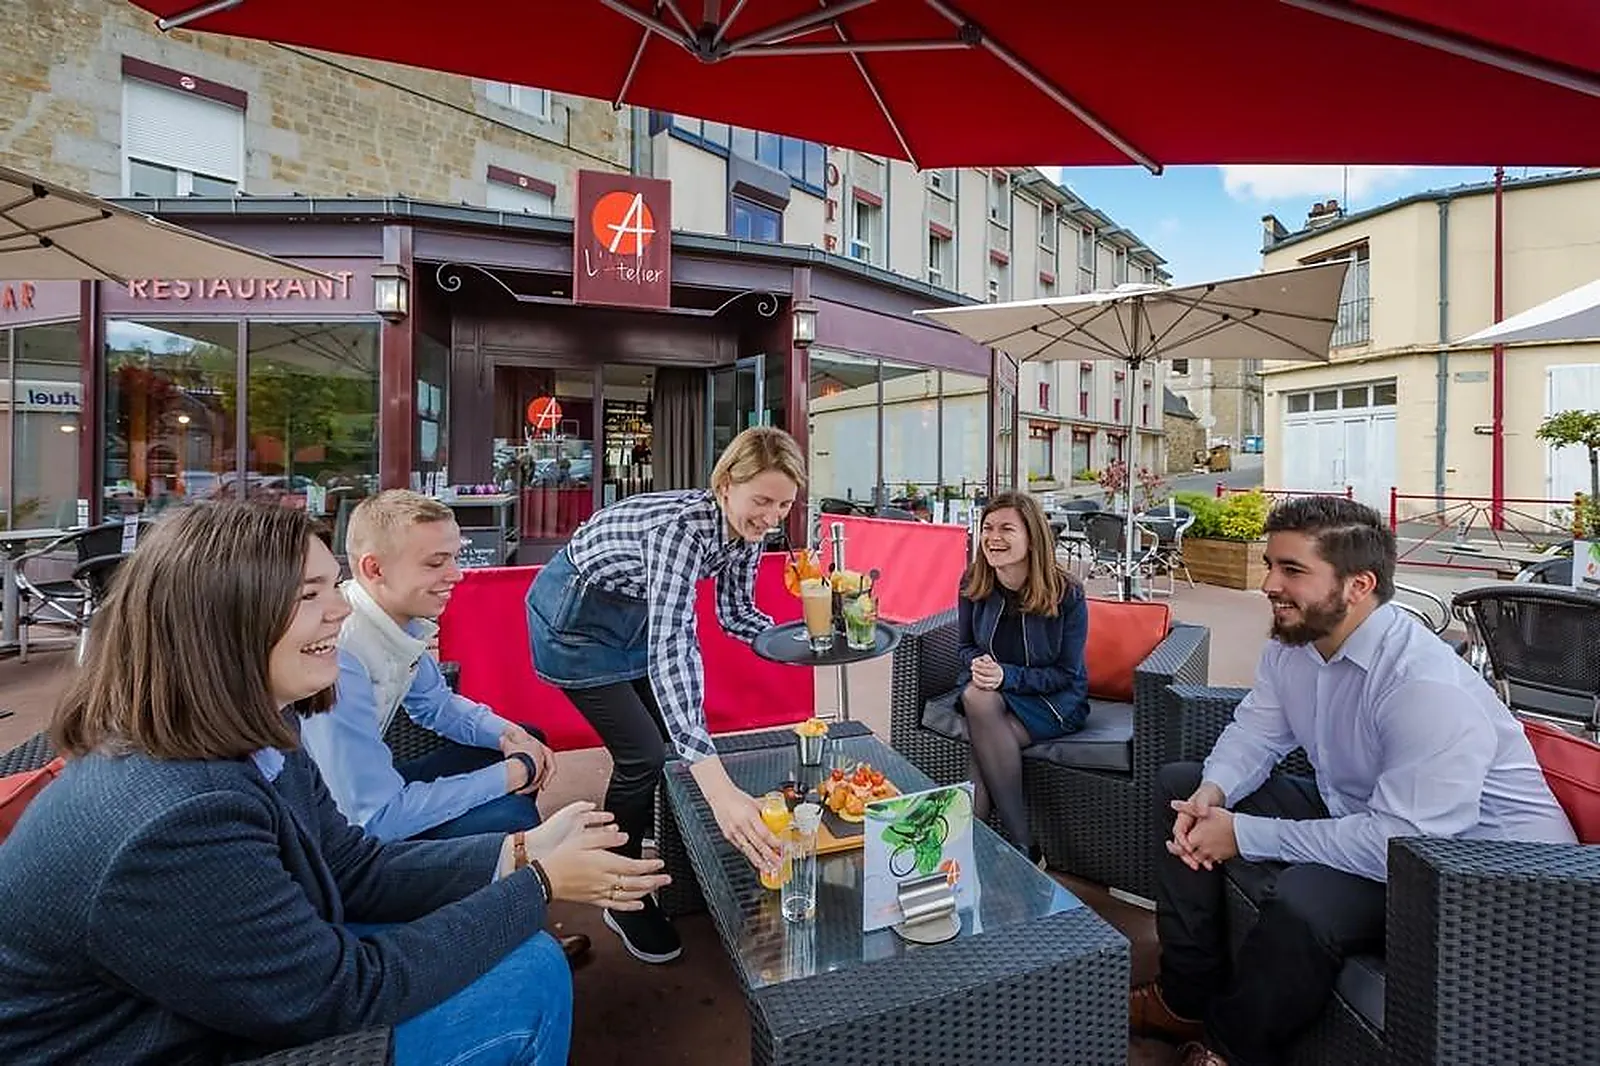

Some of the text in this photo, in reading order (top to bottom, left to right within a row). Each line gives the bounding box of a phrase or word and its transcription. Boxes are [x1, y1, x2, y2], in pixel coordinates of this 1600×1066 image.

[607, 193, 656, 257] A
[824, 163, 839, 252] OTE
[2, 281, 36, 311] AR
[128, 271, 353, 299] RESTAURANT
